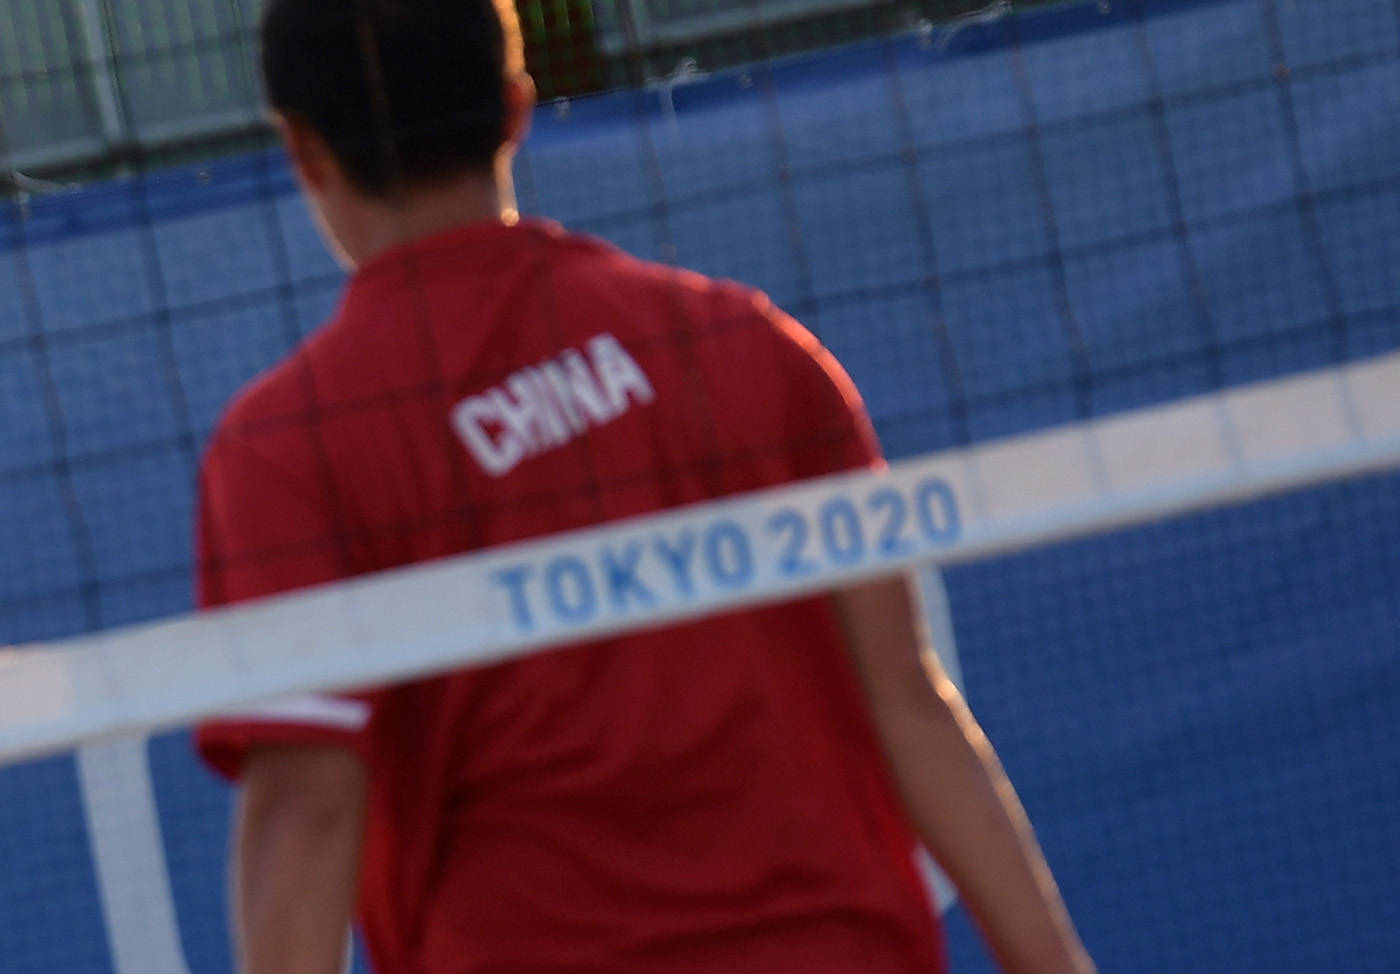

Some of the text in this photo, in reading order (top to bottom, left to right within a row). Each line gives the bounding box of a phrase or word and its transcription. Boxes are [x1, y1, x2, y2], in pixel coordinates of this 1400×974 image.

[451, 333, 655, 476] CHINA
[492, 477, 962, 635] TOKYO 2020
